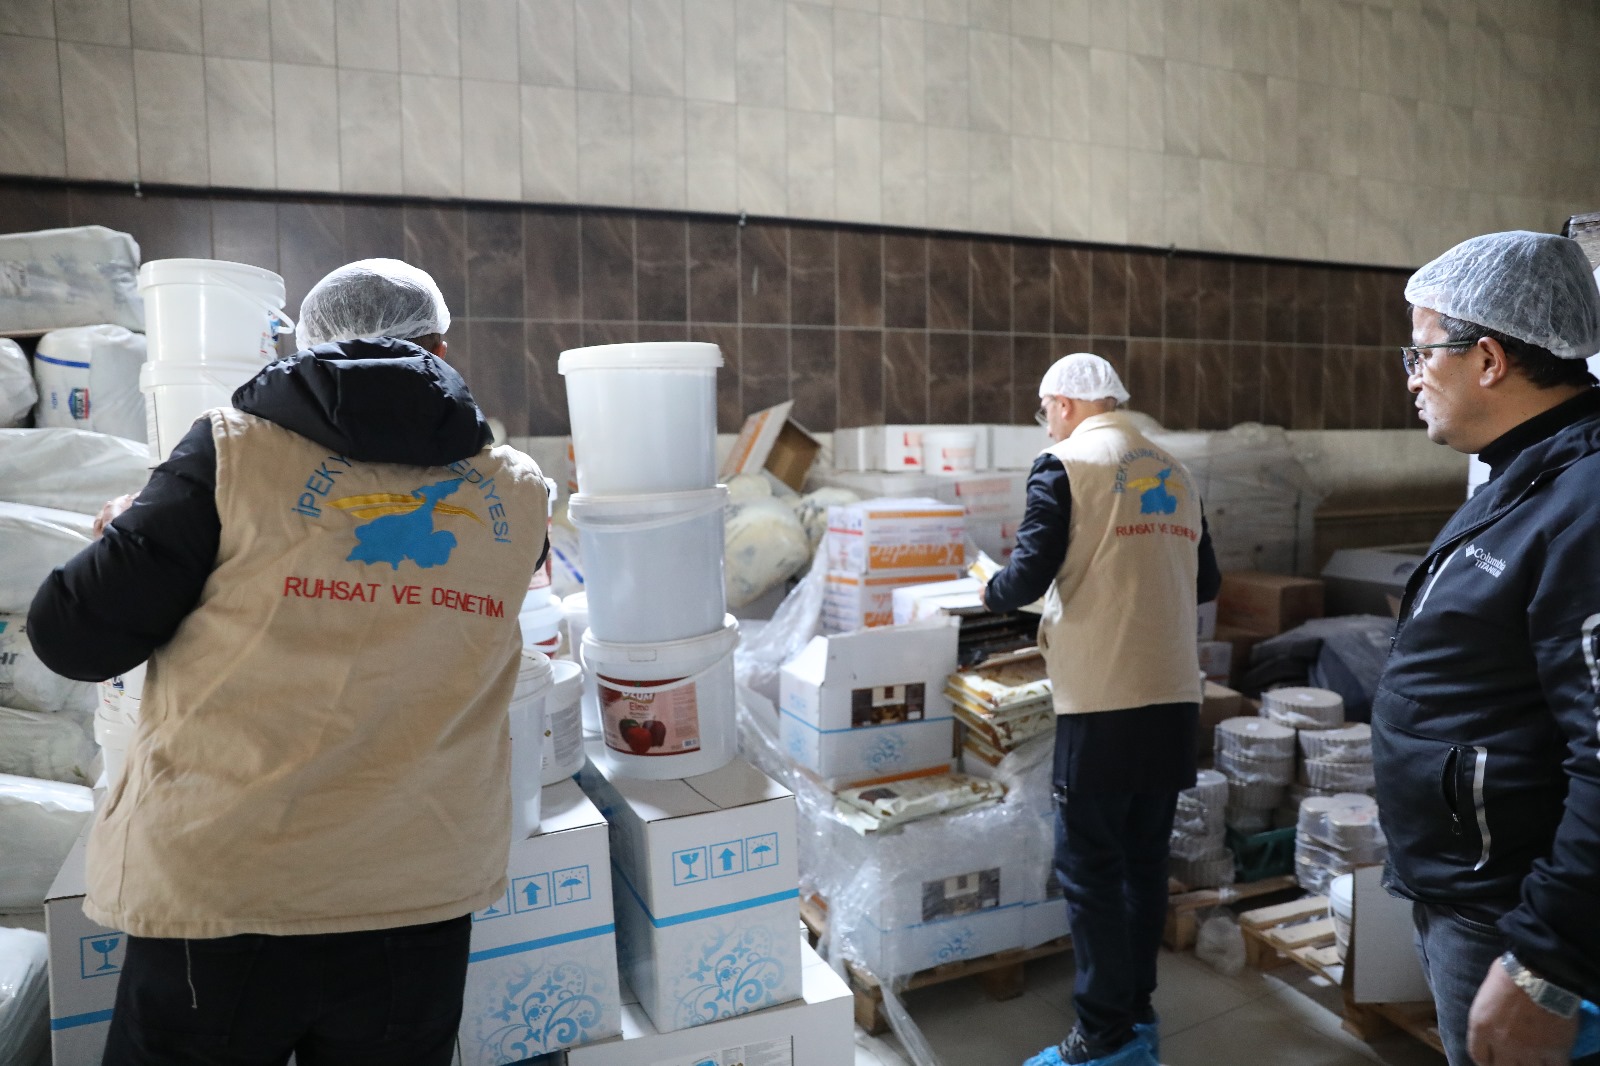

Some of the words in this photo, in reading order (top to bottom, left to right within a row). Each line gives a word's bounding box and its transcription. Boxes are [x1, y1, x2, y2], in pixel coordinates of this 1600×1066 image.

[291, 455, 352, 519] İPEKY
[1474, 548, 1506, 571] Columbia
[1475, 560, 1502, 578] TITANIUM
[283, 577, 381, 603] RUHSAT
[391, 584, 422, 604] VE
[431, 587, 504, 618] DENETİM
